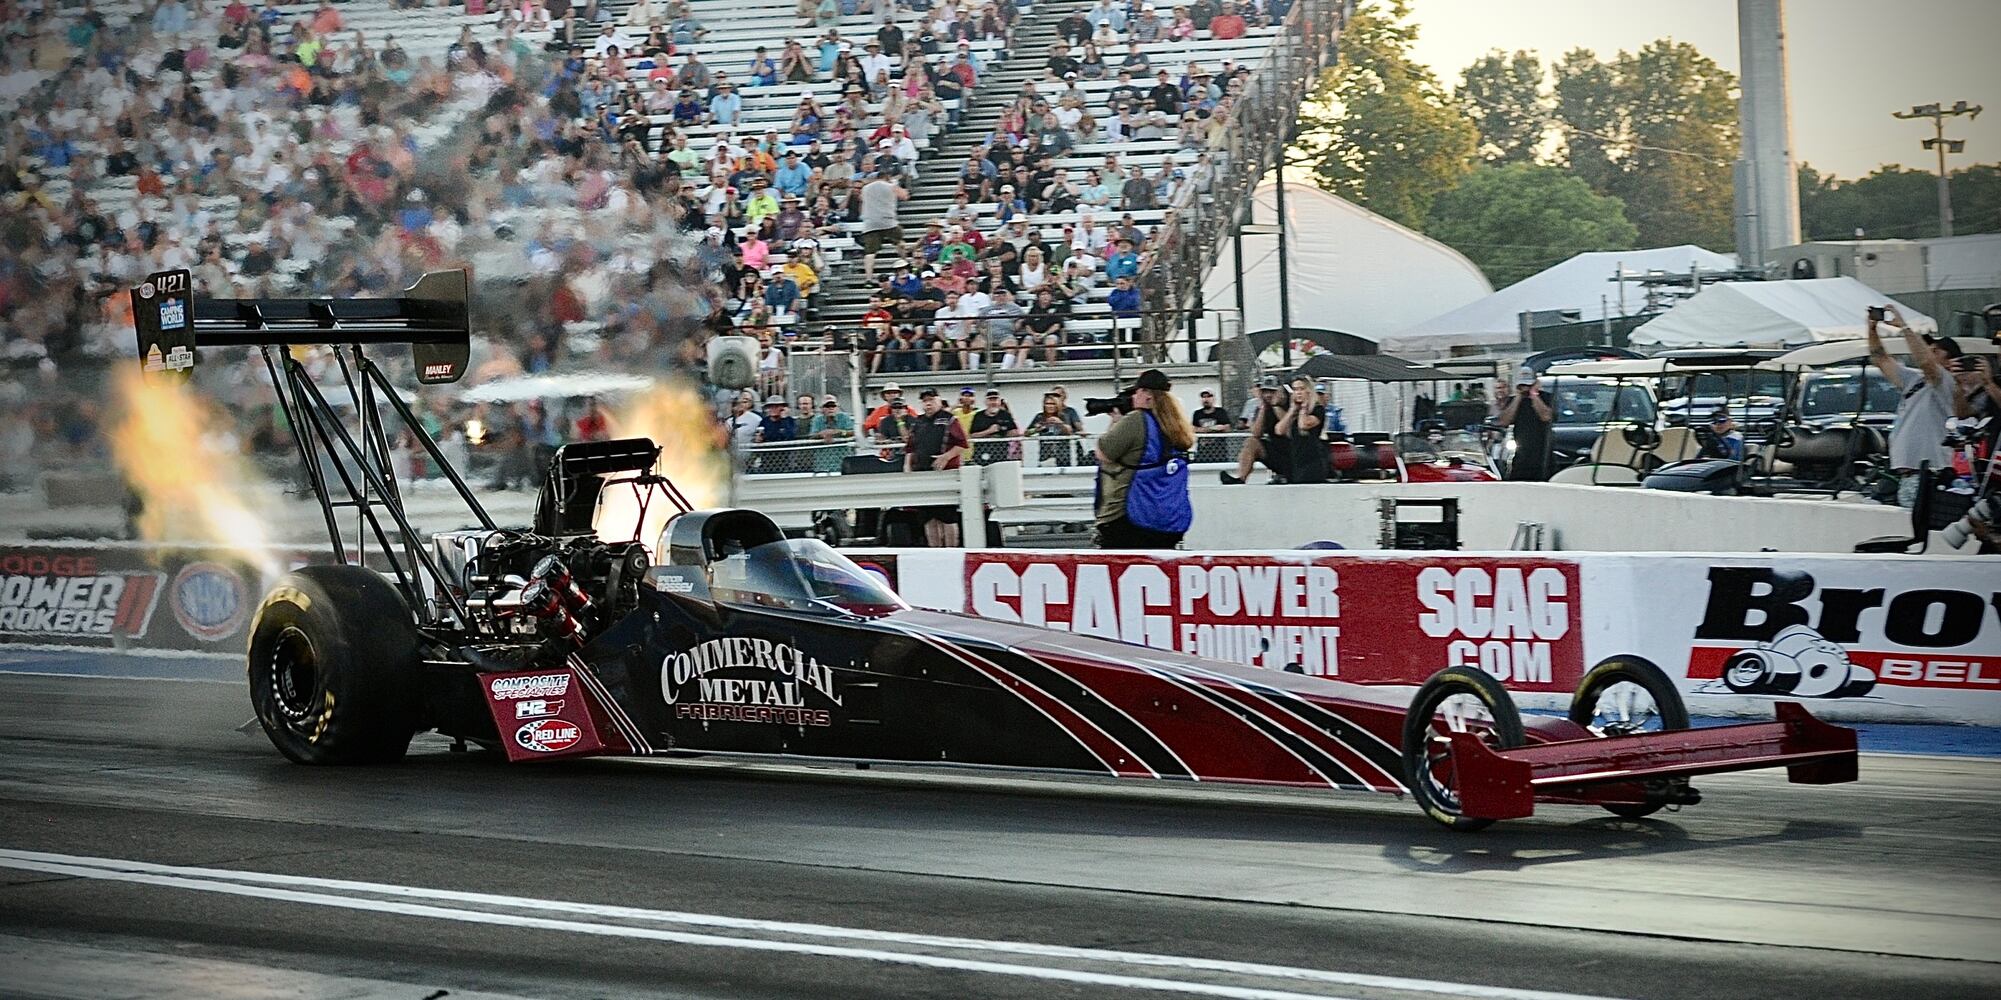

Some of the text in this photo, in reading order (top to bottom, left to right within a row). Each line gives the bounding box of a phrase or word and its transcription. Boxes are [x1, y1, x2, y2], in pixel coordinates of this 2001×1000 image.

[157, 273, 185, 294] 421
[161, 313, 185, 325] WORLD
[425, 364, 452, 375] MANLEY
[0, 556, 97, 575] ODGE
[0, 574, 125, 609] OWER
[1416, 567, 1569, 640] SCAG
[971, 563, 1340, 651] SCAG POWER
[1695, 567, 2001, 647] Bro
[1180, 623, 1340, 675] EQUIPMENT
[1448, 640, 1552, 682] COM
[492, 674, 570, 691] COMPOSITE
[661, 637, 842, 706] COMMERCIAL
[1880, 659, 2001, 683] BEL
[494, 685, 566, 700] SPECIALTIES
[698, 678, 804, 707] METAL
[675, 702, 831, 727] FABRICATORS
[535, 729, 555, 741] RED
[556, 727, 579, 739] LINE
